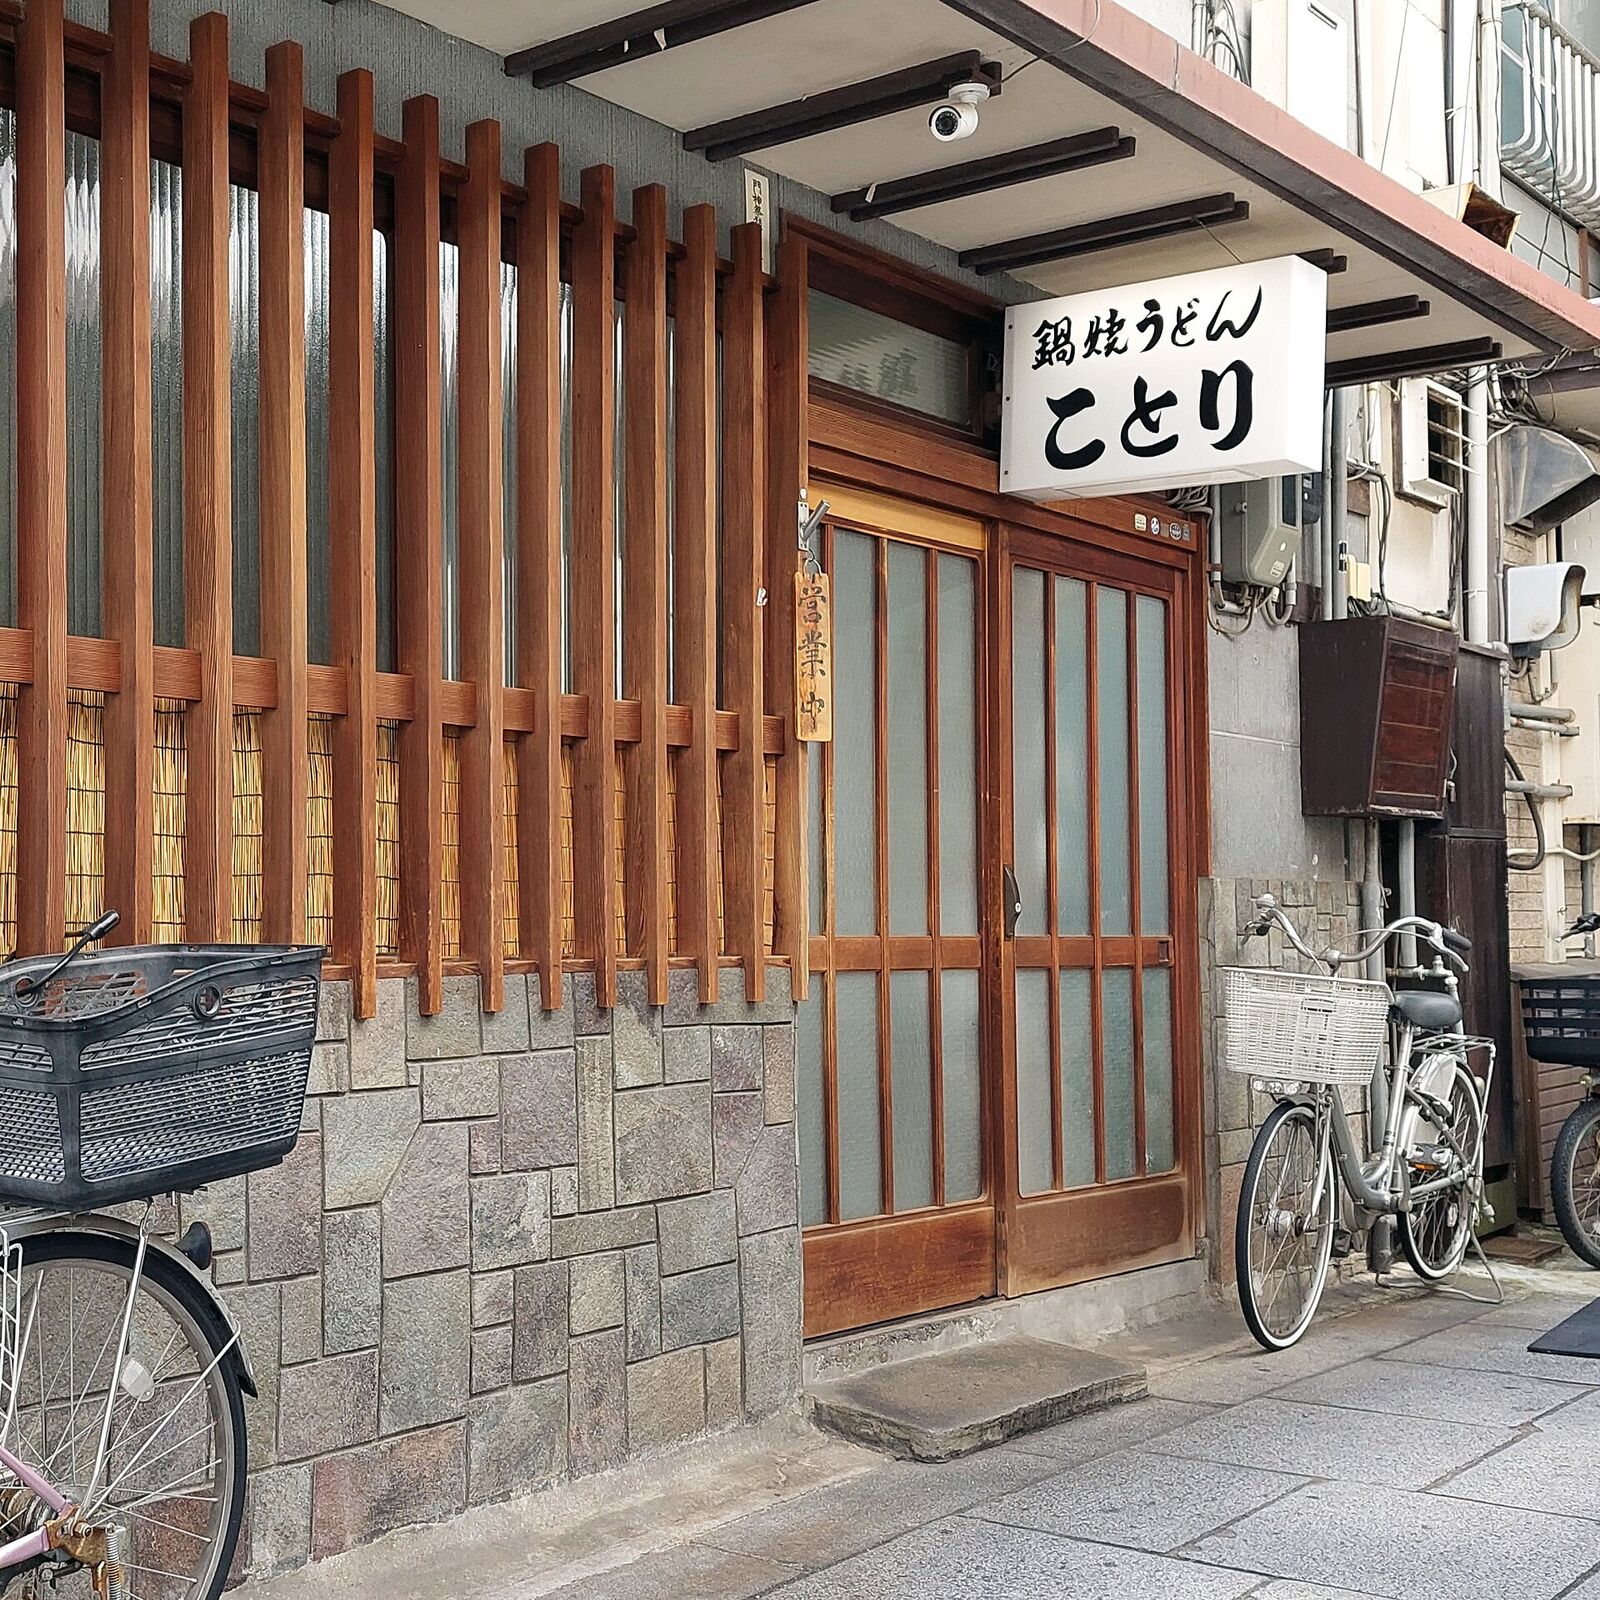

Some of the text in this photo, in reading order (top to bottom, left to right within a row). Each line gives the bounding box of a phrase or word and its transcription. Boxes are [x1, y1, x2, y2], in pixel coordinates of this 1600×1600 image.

[1031, 286, 1262, 371] 鍋焼うどん
[1045, 360, 1254, 470] ことり
[797, 585, 828, 734] 営業中
